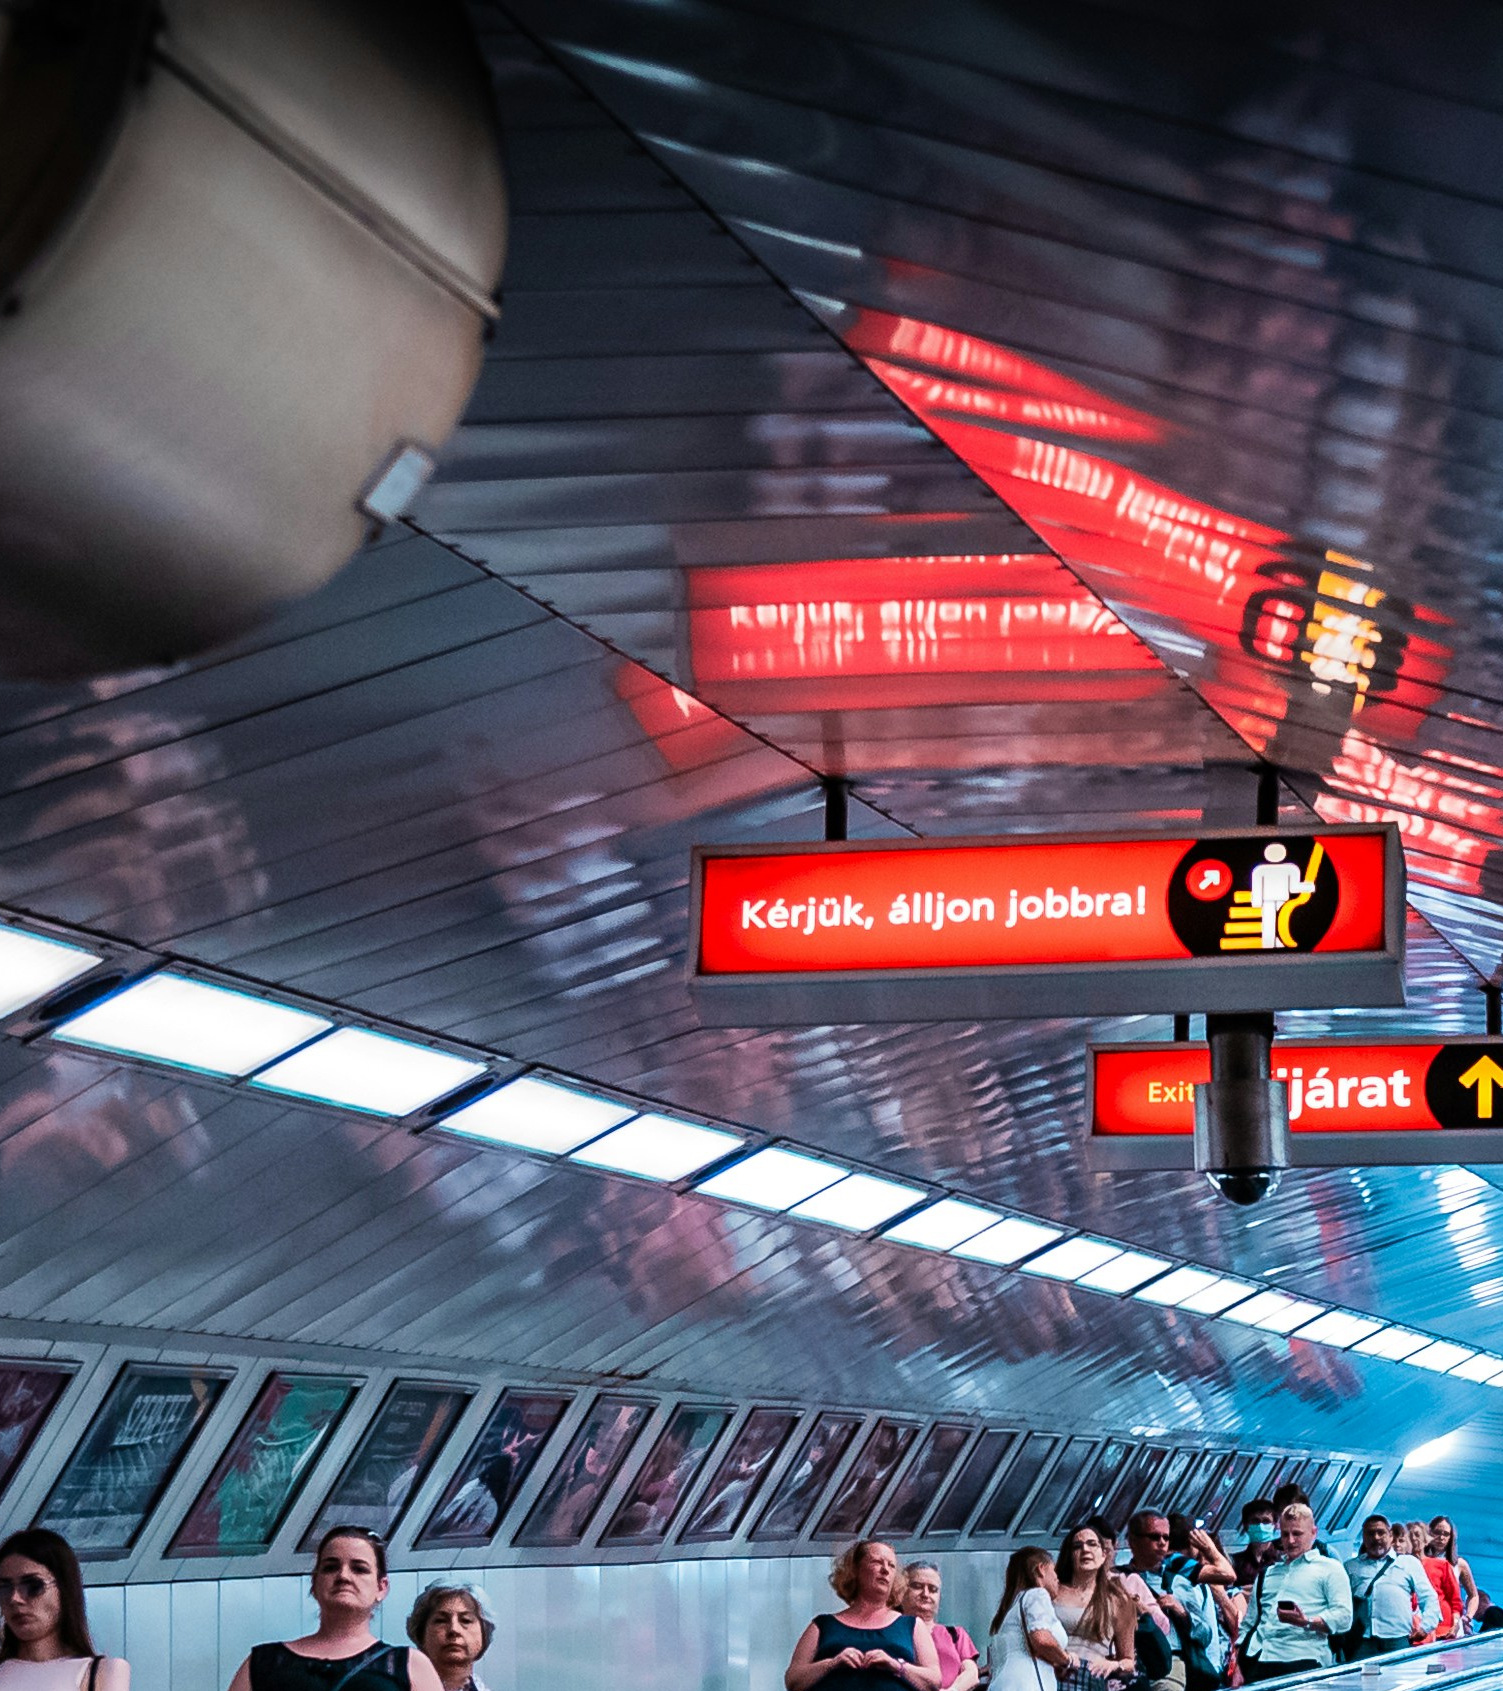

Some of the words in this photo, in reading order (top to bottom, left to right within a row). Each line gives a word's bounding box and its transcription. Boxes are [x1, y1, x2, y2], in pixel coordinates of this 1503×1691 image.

[740, 894, 875, 936] Kérjük,
[887, 891, 995, 931] álljon
[1004, 884, 1147, 929] jobbra!
[1275, 1066, 1412, 1121] járat
